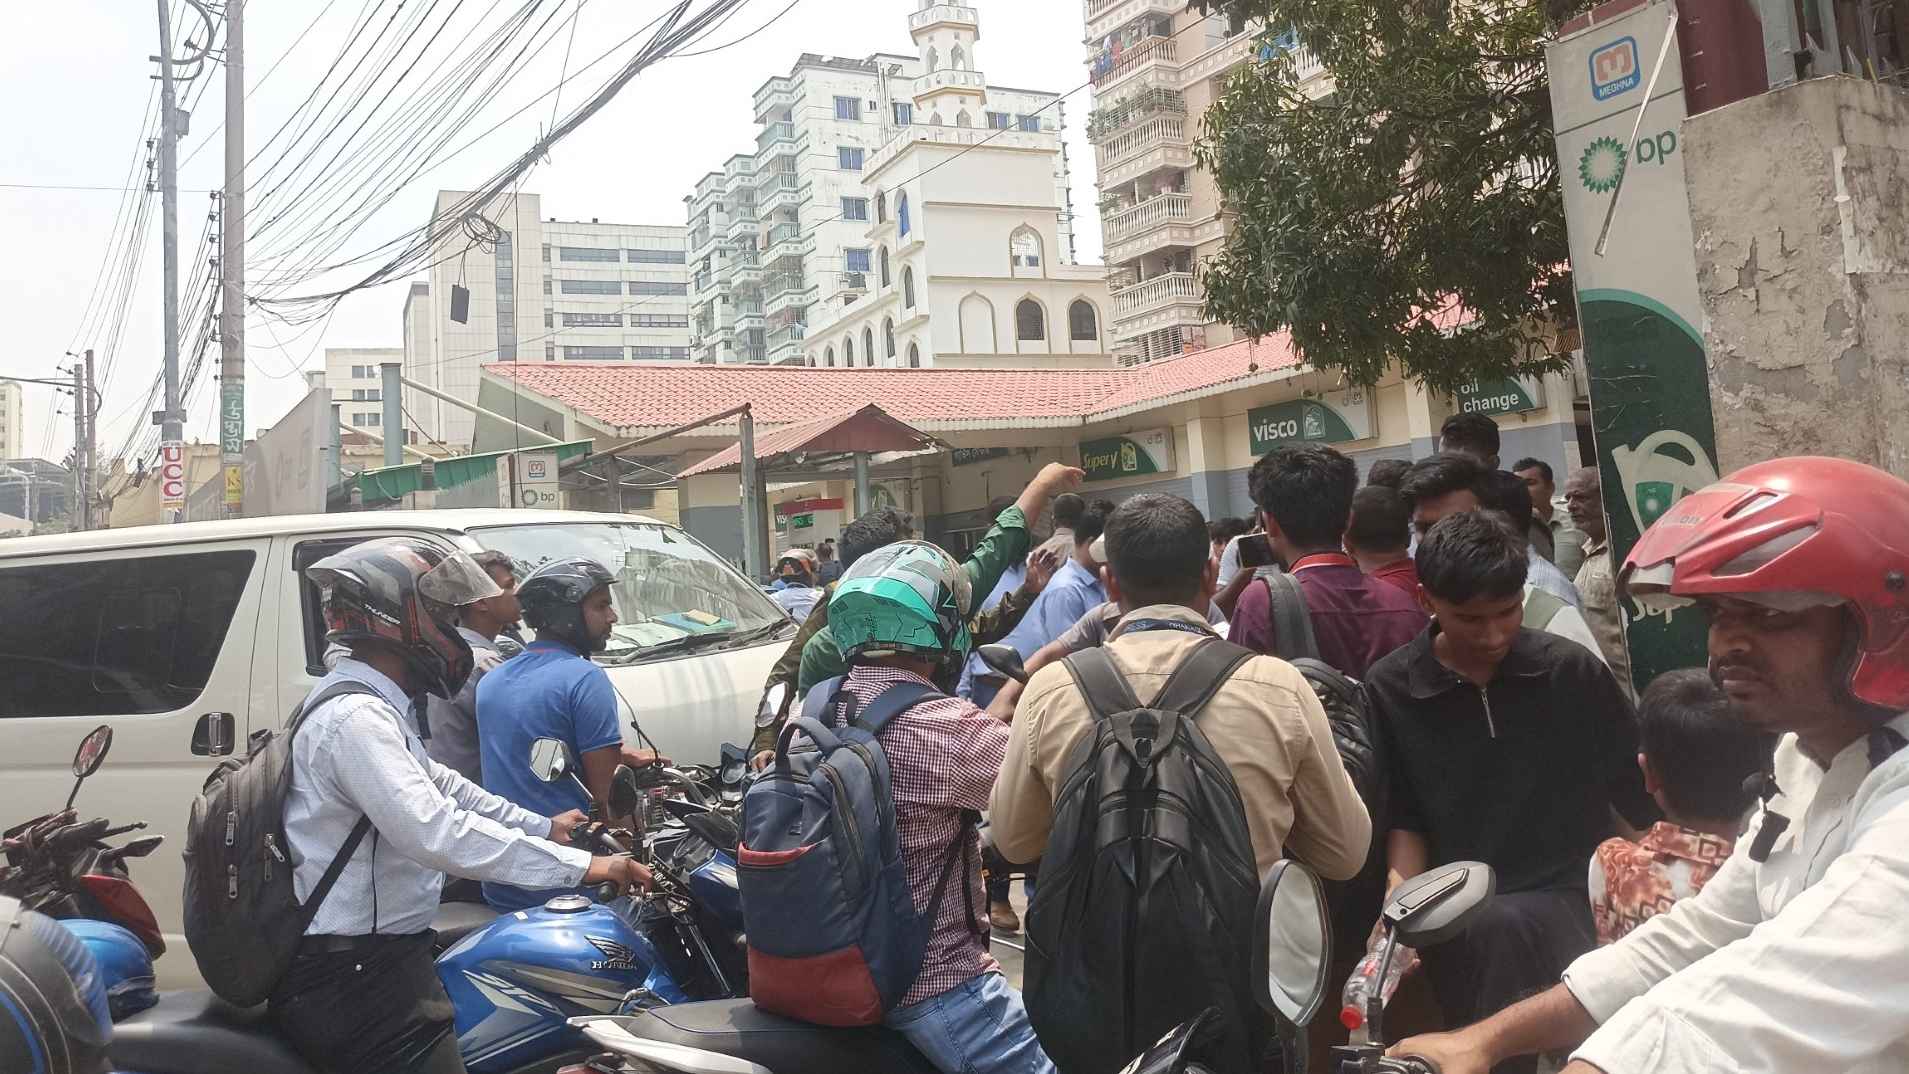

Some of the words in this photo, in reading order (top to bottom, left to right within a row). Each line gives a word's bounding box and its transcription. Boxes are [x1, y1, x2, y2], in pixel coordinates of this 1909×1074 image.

[1598, 76, 1635, 98] MEGHNA
[1636, 130, 1677, 165] bp
[1463, 393, 1520, 413] change
[162, 446, 183, 497] UCC
[541, 491, 555, 503] bp
